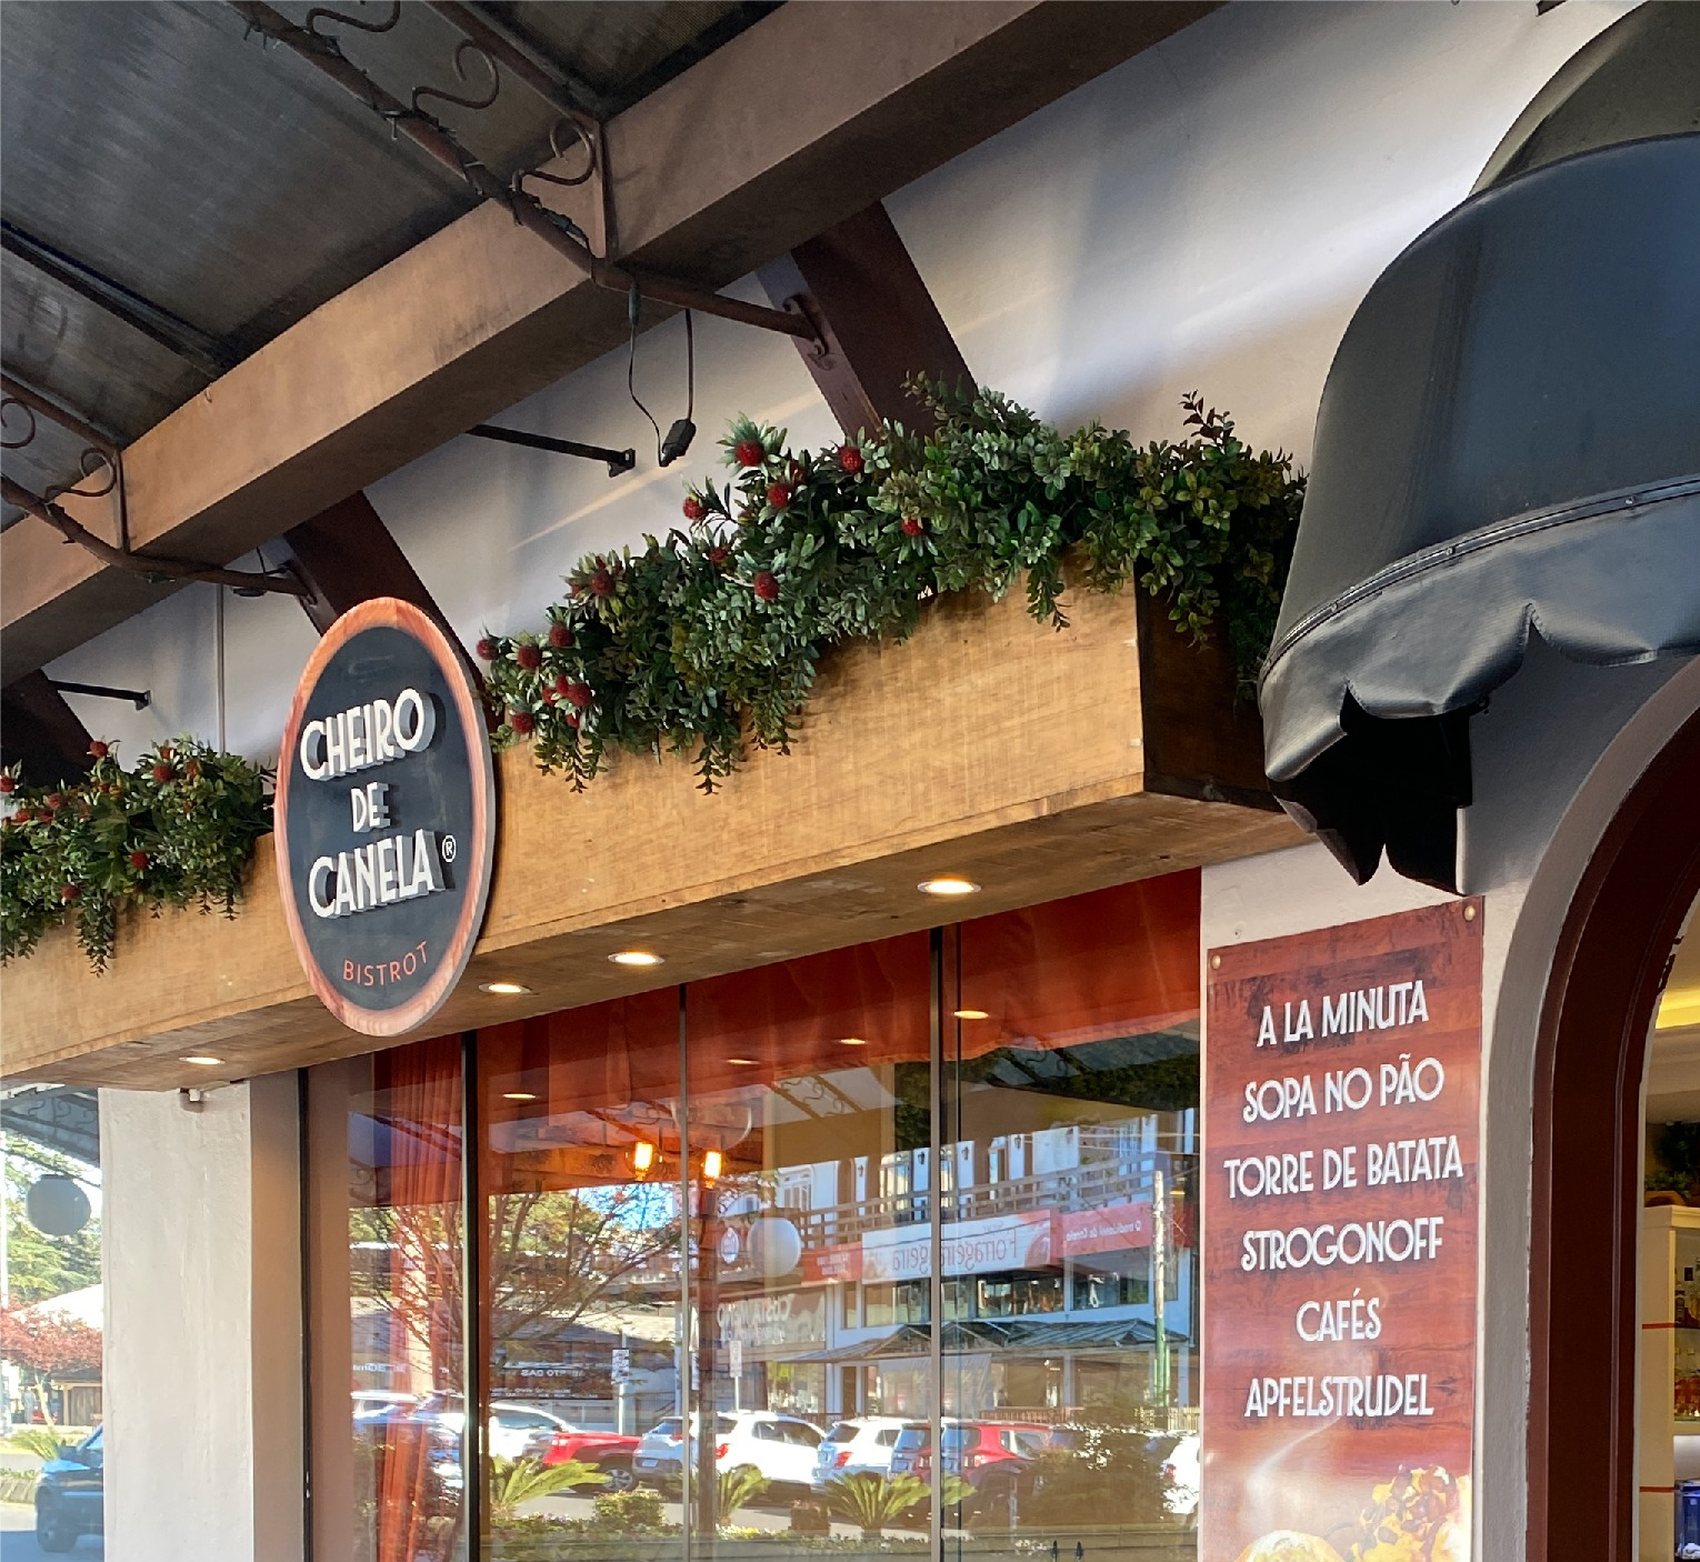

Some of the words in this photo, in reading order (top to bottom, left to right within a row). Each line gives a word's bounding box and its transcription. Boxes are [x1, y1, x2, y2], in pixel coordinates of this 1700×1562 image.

[300, 687, 433, 782] CHEIRO
[350, 782, 391, 833] DE
[308, 828, 443, 920] CANELA
[343, 940, 429, 986] BISTROT
[1257, 1005, 1277, 1048] A
[1283, 999, 1314, 1043] LA
[1320, 980, 1429, 1039] MINUTA
[1242, 1075, 1317, 1125] SOPA
[1324, 1067, 1373, 1113] NO
[1379, 1052, 1445, 1103] PÃO
[1223, 1151, 1314, 1200] TORRE
[1322, 1145, 1357, 1190] DE
[1367, 1134, 1464, 1187] BATATA
[1240, 1216, 1444, 1273] STROGONOFF
[1296, 1288, 1382, 1342] CAFÉS
[1244, 1373, 1434, 1418] APFELSTRUDEL
